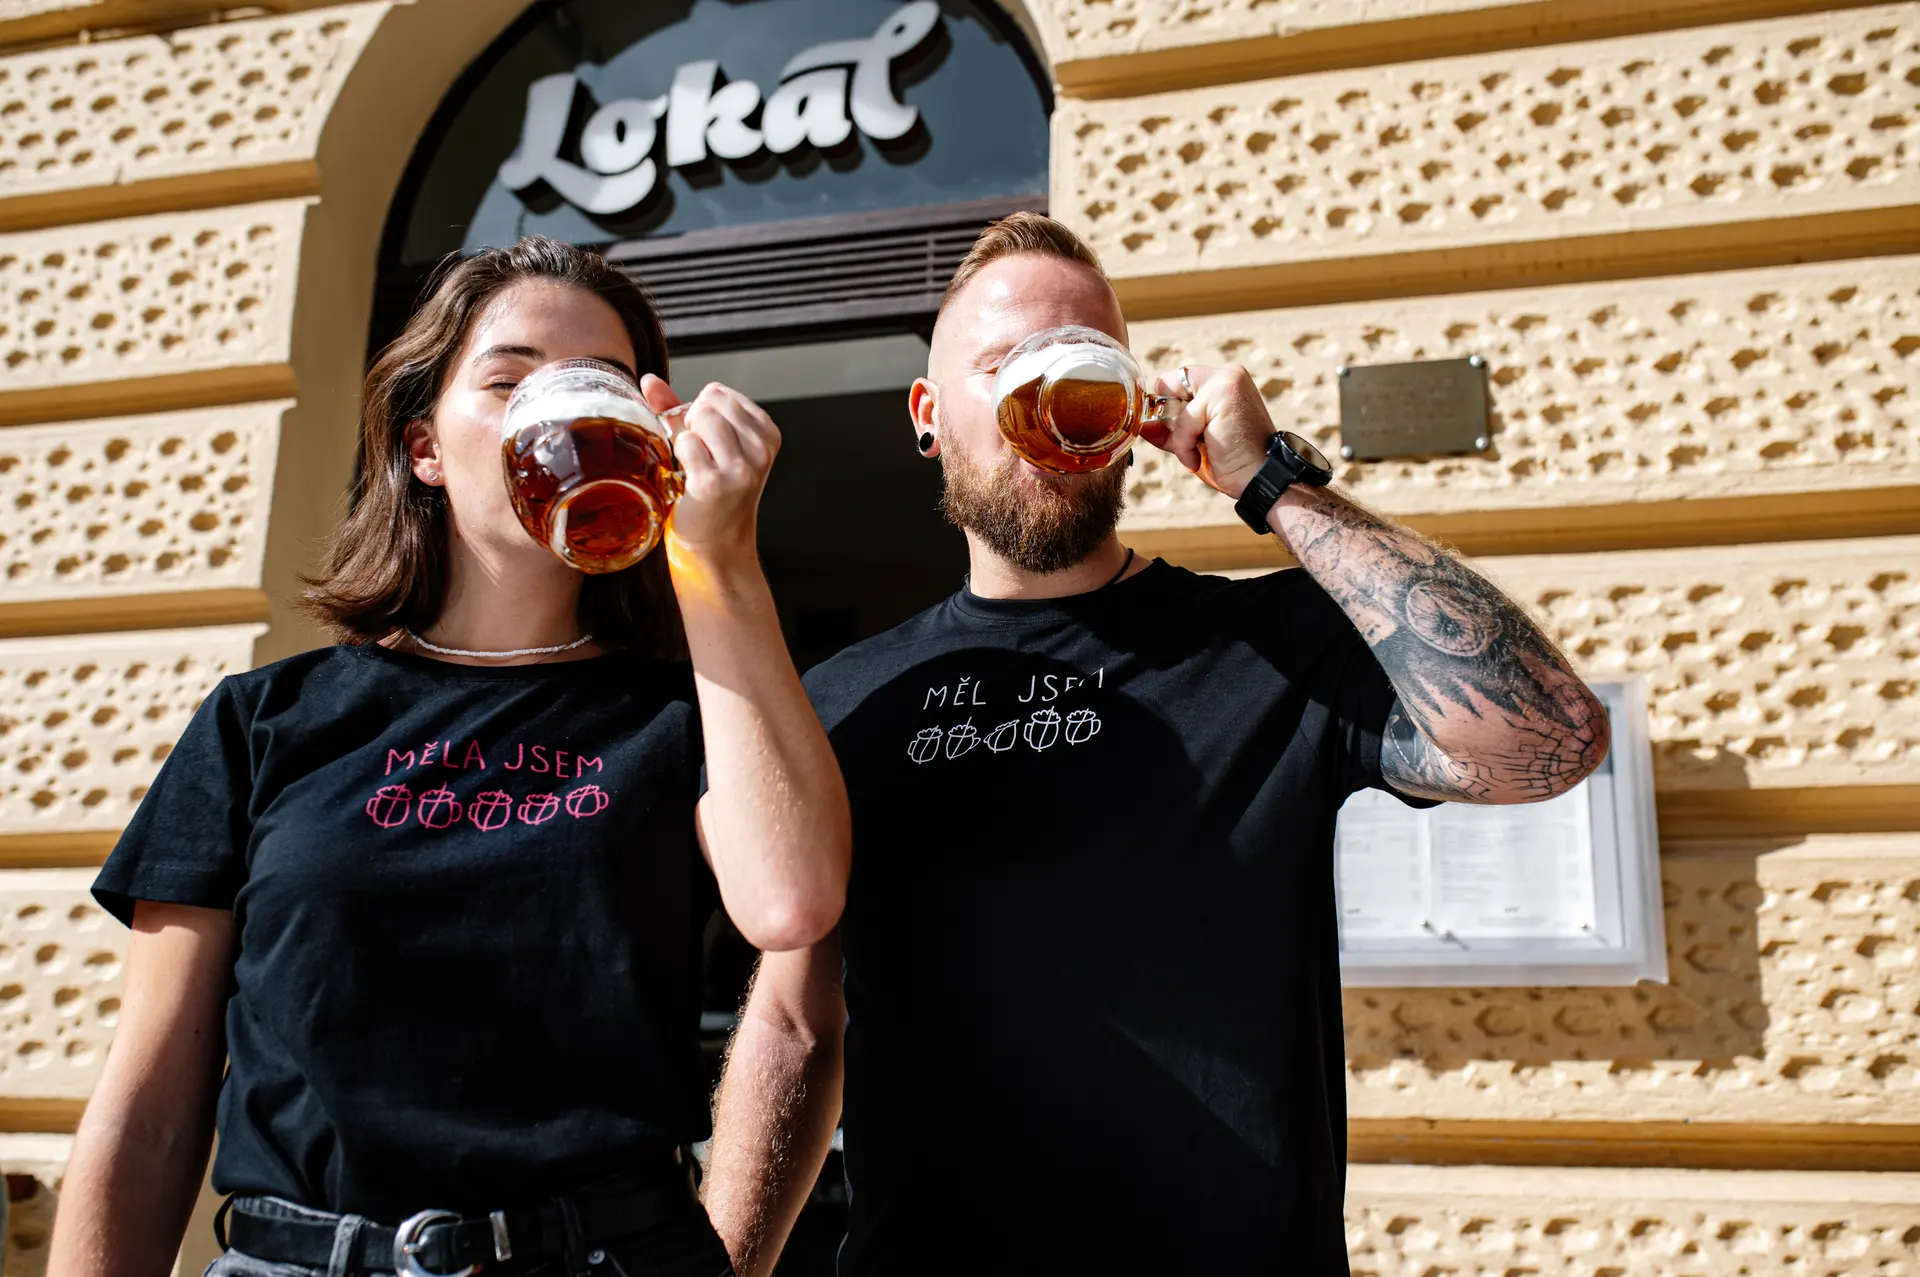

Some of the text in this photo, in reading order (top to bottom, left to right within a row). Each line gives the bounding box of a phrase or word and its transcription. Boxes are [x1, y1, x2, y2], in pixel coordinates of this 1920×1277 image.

[923, 676, 987, 710] MĚL
[384, 740, 603, 778] MĚLA JSEM
